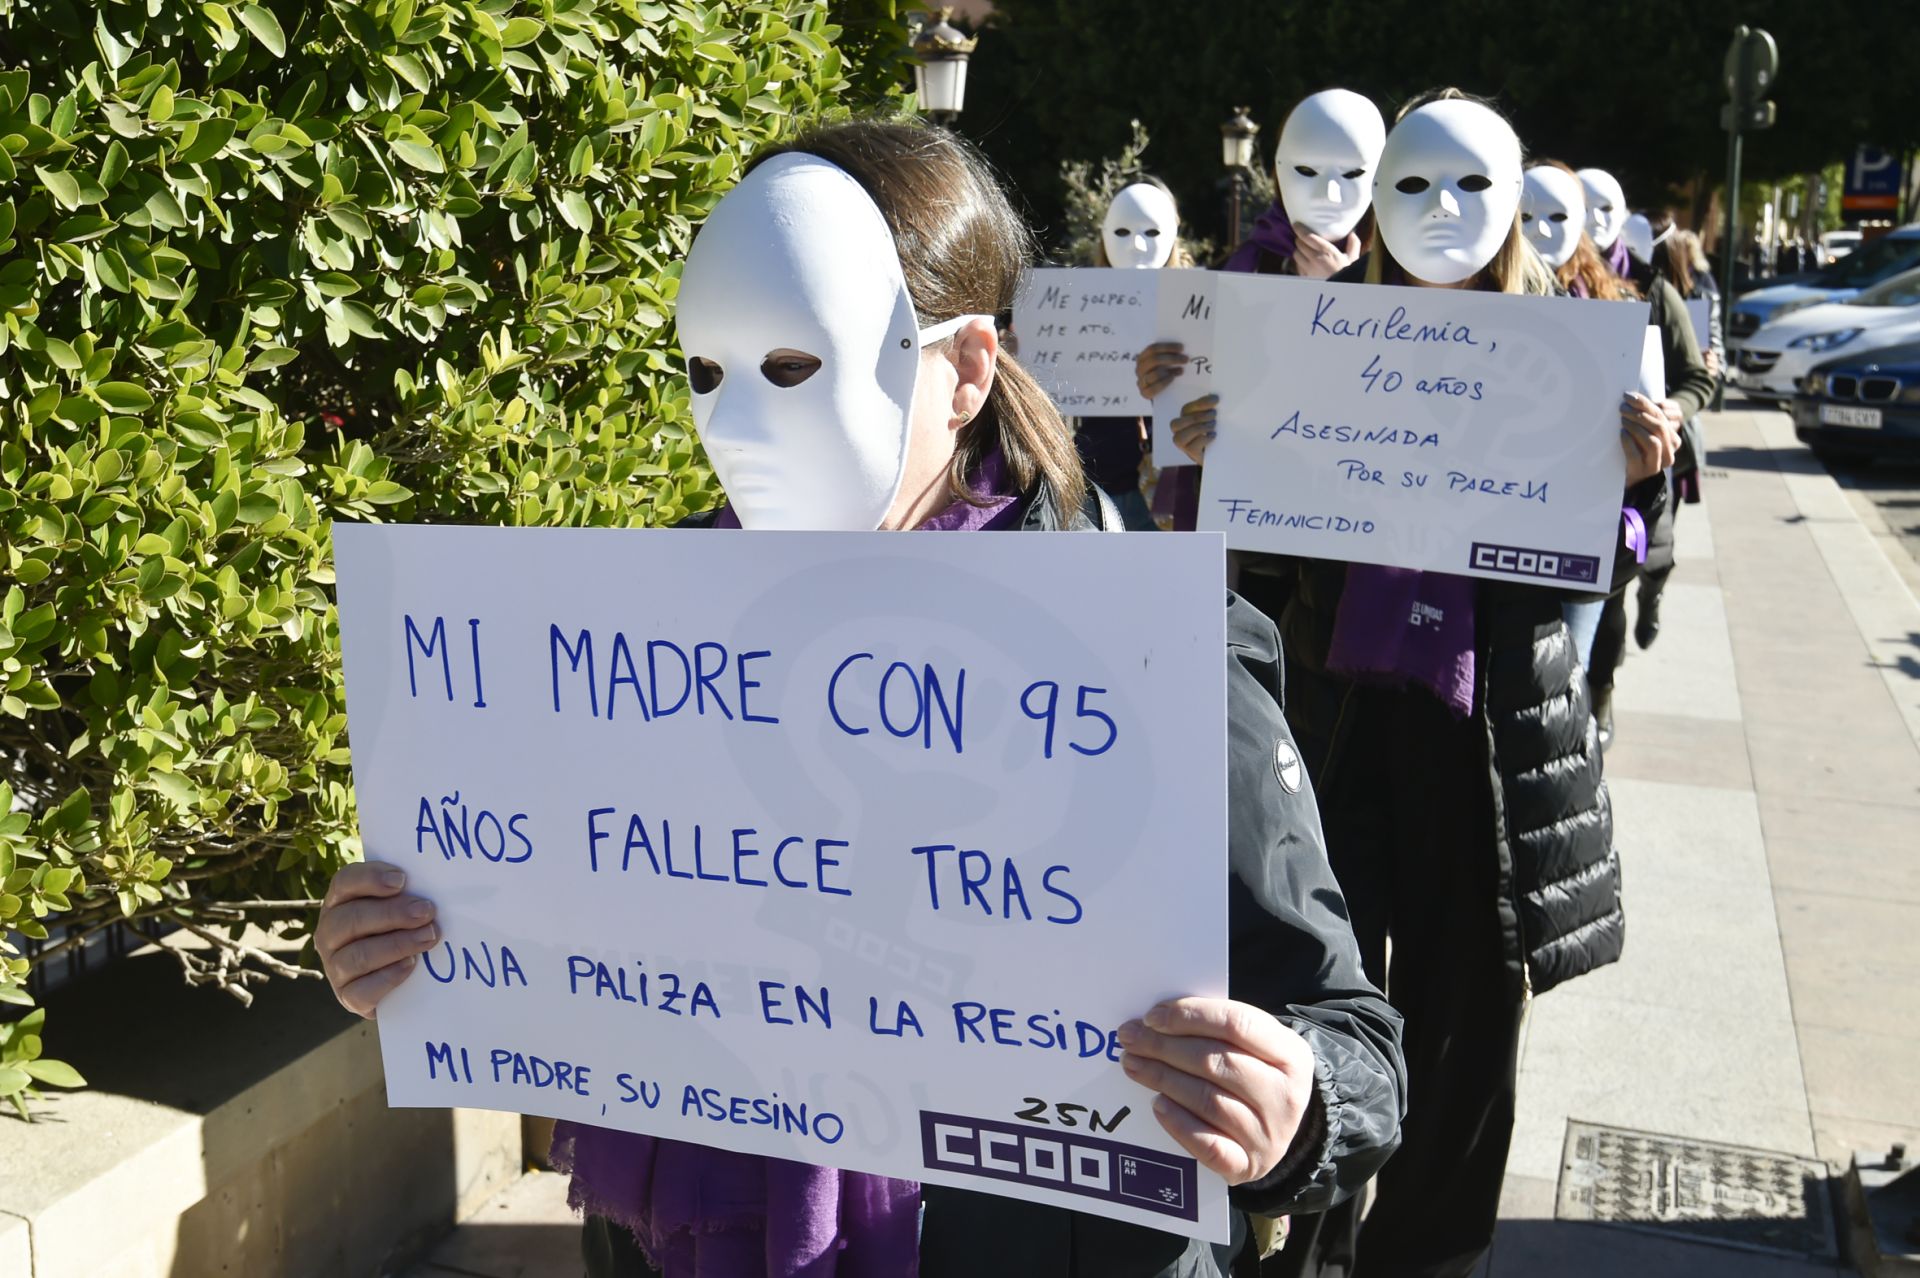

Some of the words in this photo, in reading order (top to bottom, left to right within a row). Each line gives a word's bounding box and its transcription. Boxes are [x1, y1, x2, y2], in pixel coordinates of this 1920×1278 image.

[1038, 286, 1070, 311] ME
[1037, 324, 1067, 337] ME
[1033, 350, 1062, 364] ME
[1361, 354, 1403, 393] 40
[1416, 377, 1483, 401] años
[1271, 411, 1439, 447] ASESINADA
[1337, 459, 1385, 486] POR
[1401, 471, 1428, 489] SU
[1218, 498, 1375, 534] FEMINICIDIO
[1475, 546, 1560, 576] CCOO
[404, 614, 486, 708] MI
[550, 623, 779, 724] MADRE
[828, 653, 966, 754] CON
[1019, 680, 1118, 760] 95
[415, 790, 533, 863] AÑOS
[587, 806, 853, 896] FALLECE
[911, 844, 1083, 924] TRAS
[422, 940, 528, 988] UNA
[758, 981, 832, 1029] EN
[869, 997, 924, 1038] LA
[425, 1041, 473, 1084] MI
[616, 1073, 661, 1109] SU
[1014, 1097, 1131, 1134] 25N
[934, 1122, 1111, 1192] CCOO
